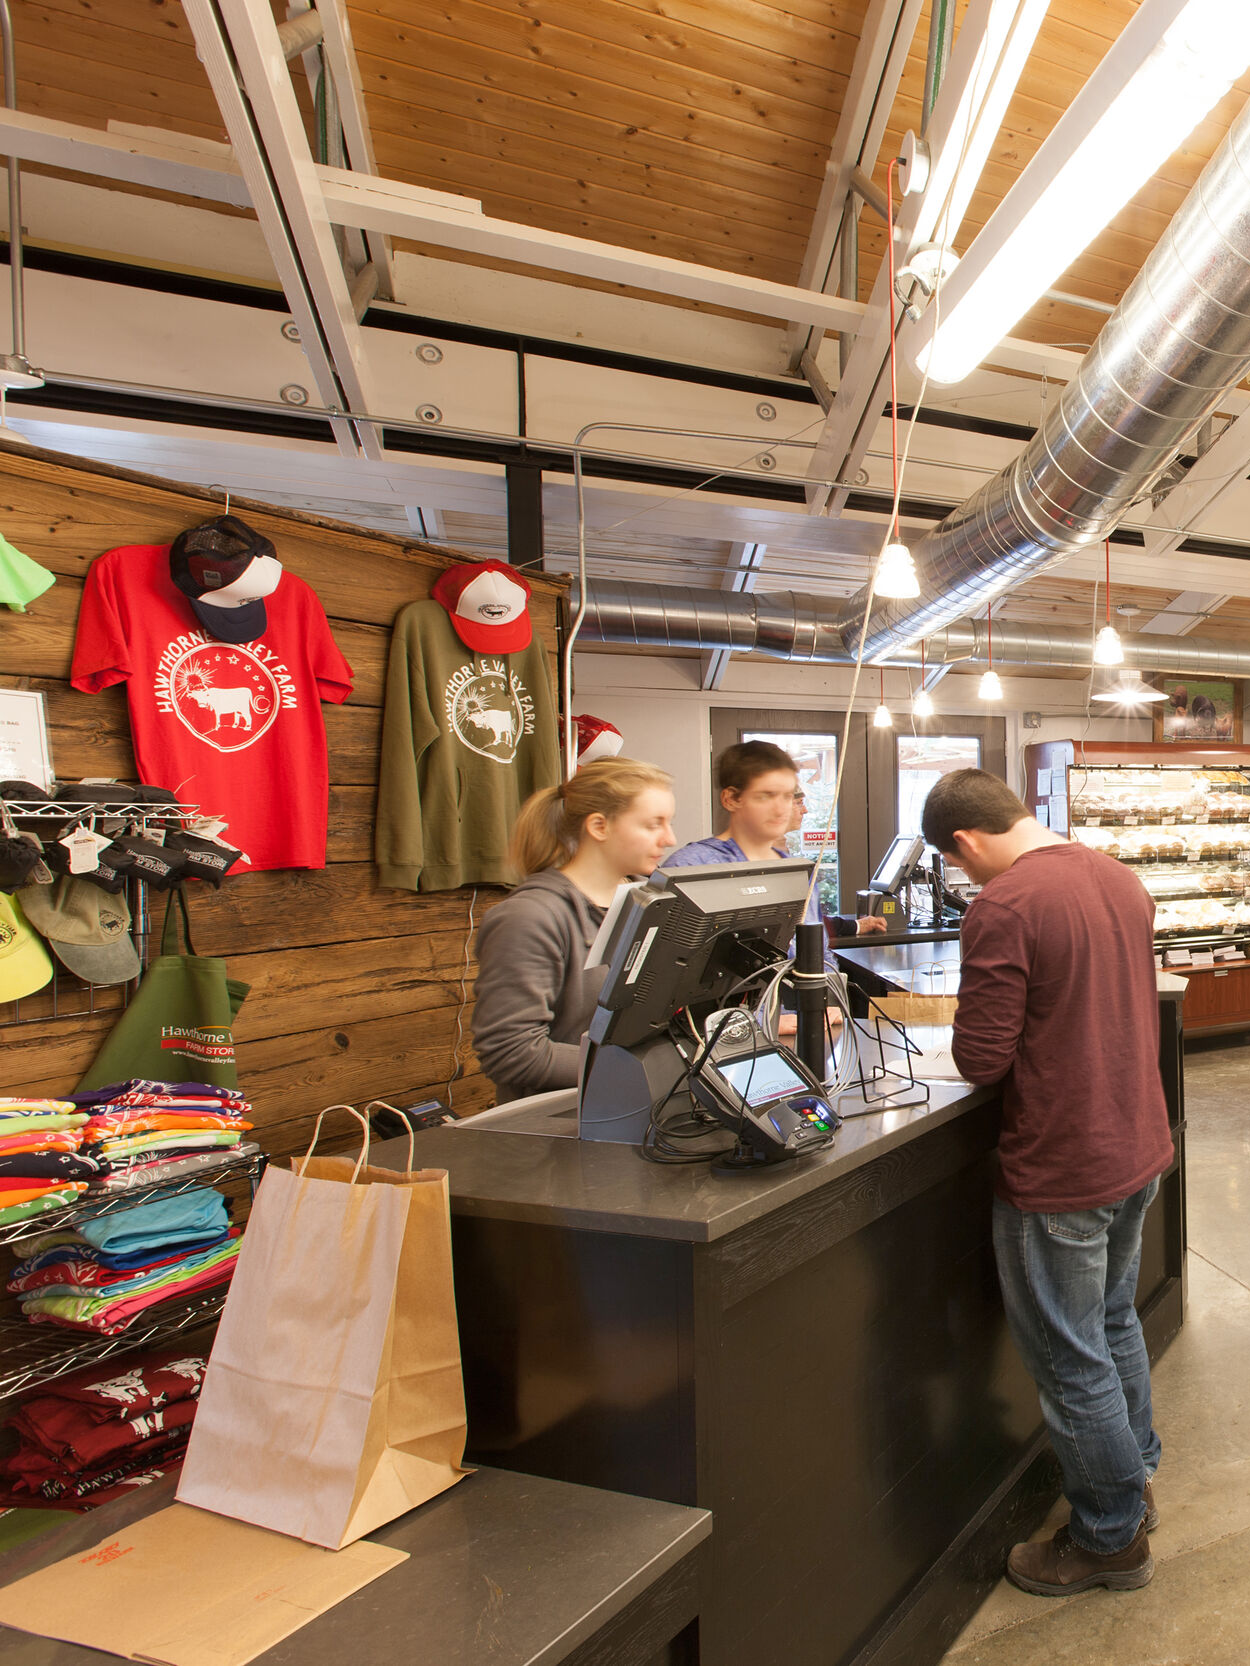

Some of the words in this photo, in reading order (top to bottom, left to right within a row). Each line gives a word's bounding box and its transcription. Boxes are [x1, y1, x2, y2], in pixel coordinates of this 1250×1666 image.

[154, 629, 213, 713] HAWTHORNE
[271, 664, 298, 709] FARM
[492, 659, 527, 692] VALEY
[519, 695, 536, 735] FARM
[161, 1026, 225, 1043] Hawthorne
[185, 1041, 205, 1054] FARM
